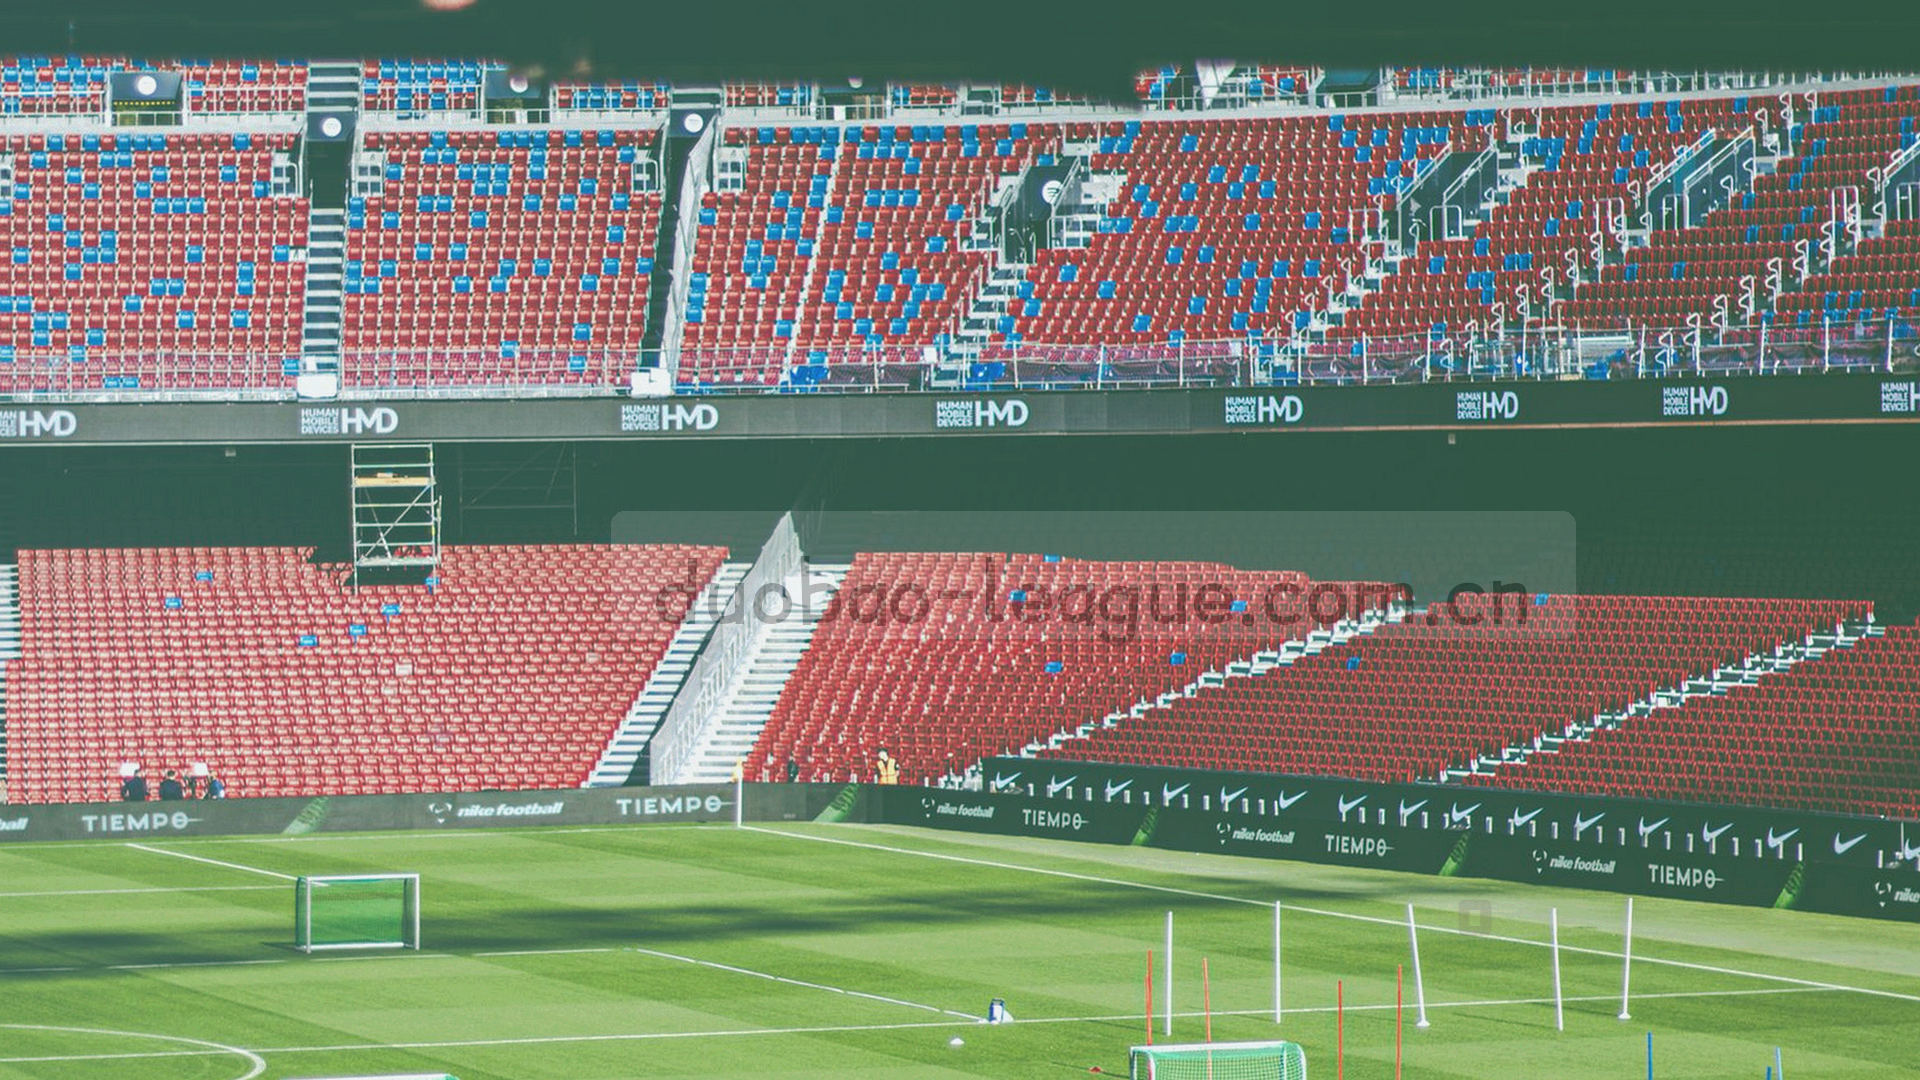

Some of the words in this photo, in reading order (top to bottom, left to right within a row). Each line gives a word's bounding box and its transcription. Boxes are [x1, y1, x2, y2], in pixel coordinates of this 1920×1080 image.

[621, 404, 660, 413] HUMAN
[936, 400, 973, 410] HUMAN
[1258, 395, 1304, 423] HMD
[1482, 391, 1519, 419] HMD
[1690, 386, 1729, 415] HMD
[301, 407, 339, 417] HUMAN
[341, 407, 399, 434] HMD
[621, 413, 660, 422] MOBILE
[661, 404, 719, 430] HMD
[936, 410, 973, 418] MOBILE
[975, 399, 1029, 426] HMD
[19, 410, 77, 437] HMD
[301, 417, 339, 426] MOBILE
[301, 425, 339, 434] DEVICES
[621, 422, 660, 431] DEVICES
[936, 418, 973, 427] DEVICES
[457, 804, 494, 817] nike
[496, 802, 564, 816] football
[616, 795, 737, 815] TIEMPO
[936, 802, 958, 814] nike
[958, 803, 995, 818] football
[82, 811, 204, 832] TIEMPO
[1022, 808, 1089, 830] TIEMPO
[1232, 827, 1254, 841] nike
[1255, 829, 1295, 844] football
[1325, 834, 1394, 857] TIEMPO
[1550, 855, 1574, 869] nike
[1574, 856, 1616, 874] football
[1648, 863, 1725, 889] TIEMPO
[1894, 887, 1920, 903] nike
